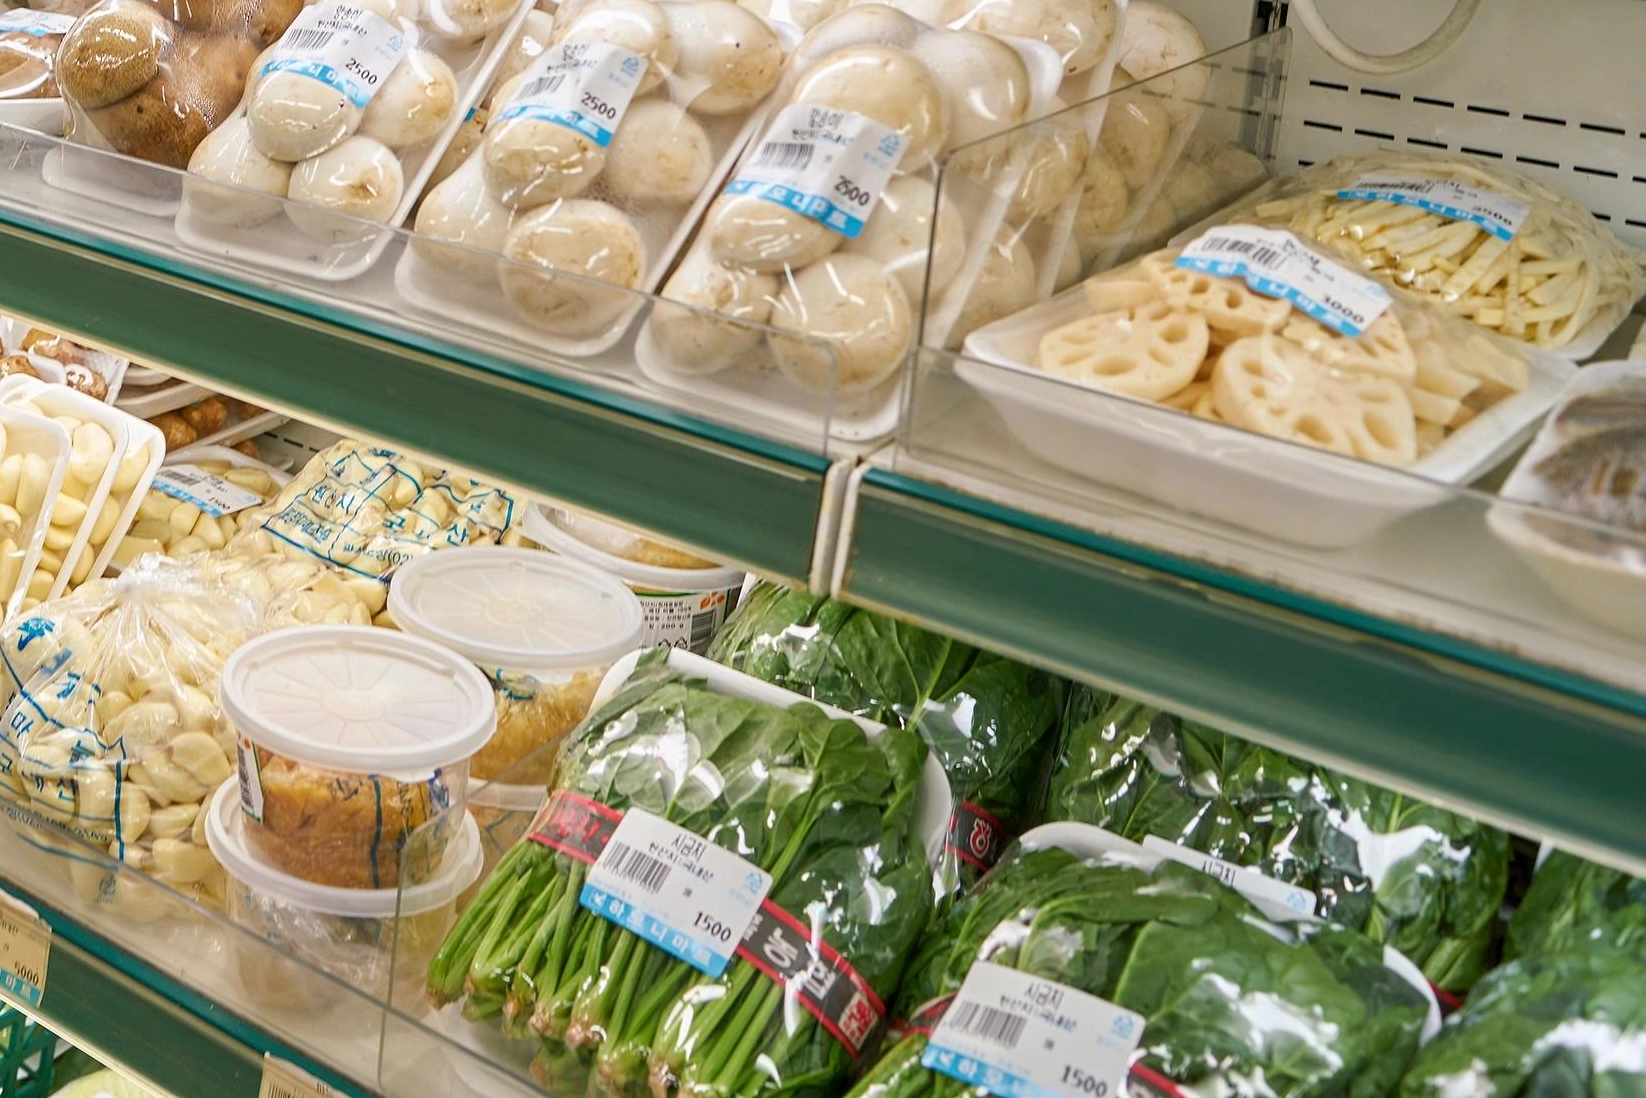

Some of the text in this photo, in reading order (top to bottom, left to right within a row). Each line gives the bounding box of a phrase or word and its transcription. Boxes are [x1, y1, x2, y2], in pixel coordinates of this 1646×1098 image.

[345, 57, 378, 85] 2500
[580, 91, 617, 120] 2500
[834, 175, 871, 207] 2500
[608, 901, 715, 969] 하모니마트
[693, 910, 733, 944] 1500
[14, 959, 40, 985] 5000
[1060, 1063, 1108, 1098] 1500
